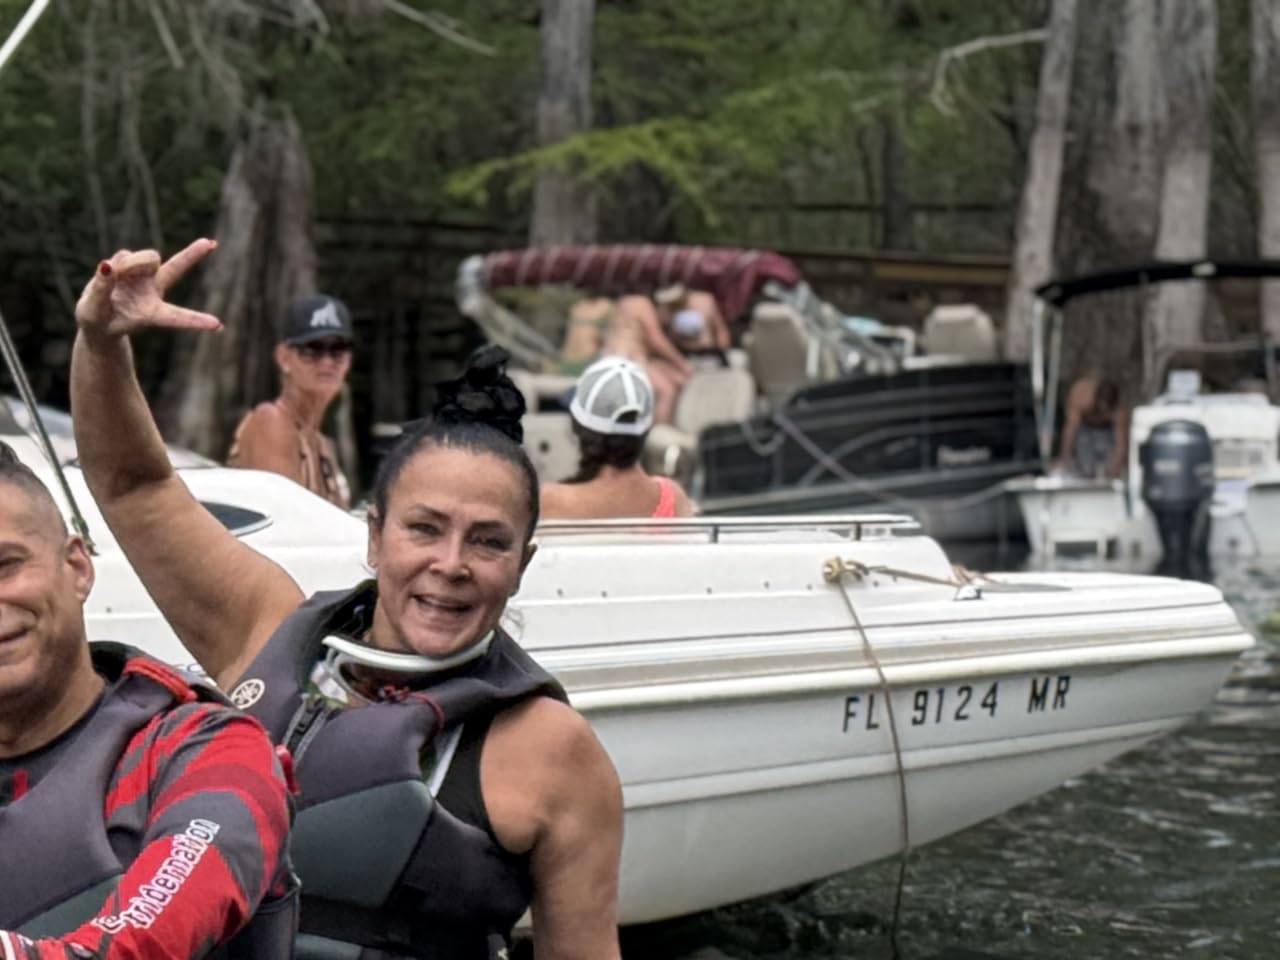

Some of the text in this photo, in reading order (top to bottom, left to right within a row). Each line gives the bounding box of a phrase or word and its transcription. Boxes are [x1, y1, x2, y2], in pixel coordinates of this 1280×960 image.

[842, 675, 1071, 732] FL 9124 MR
